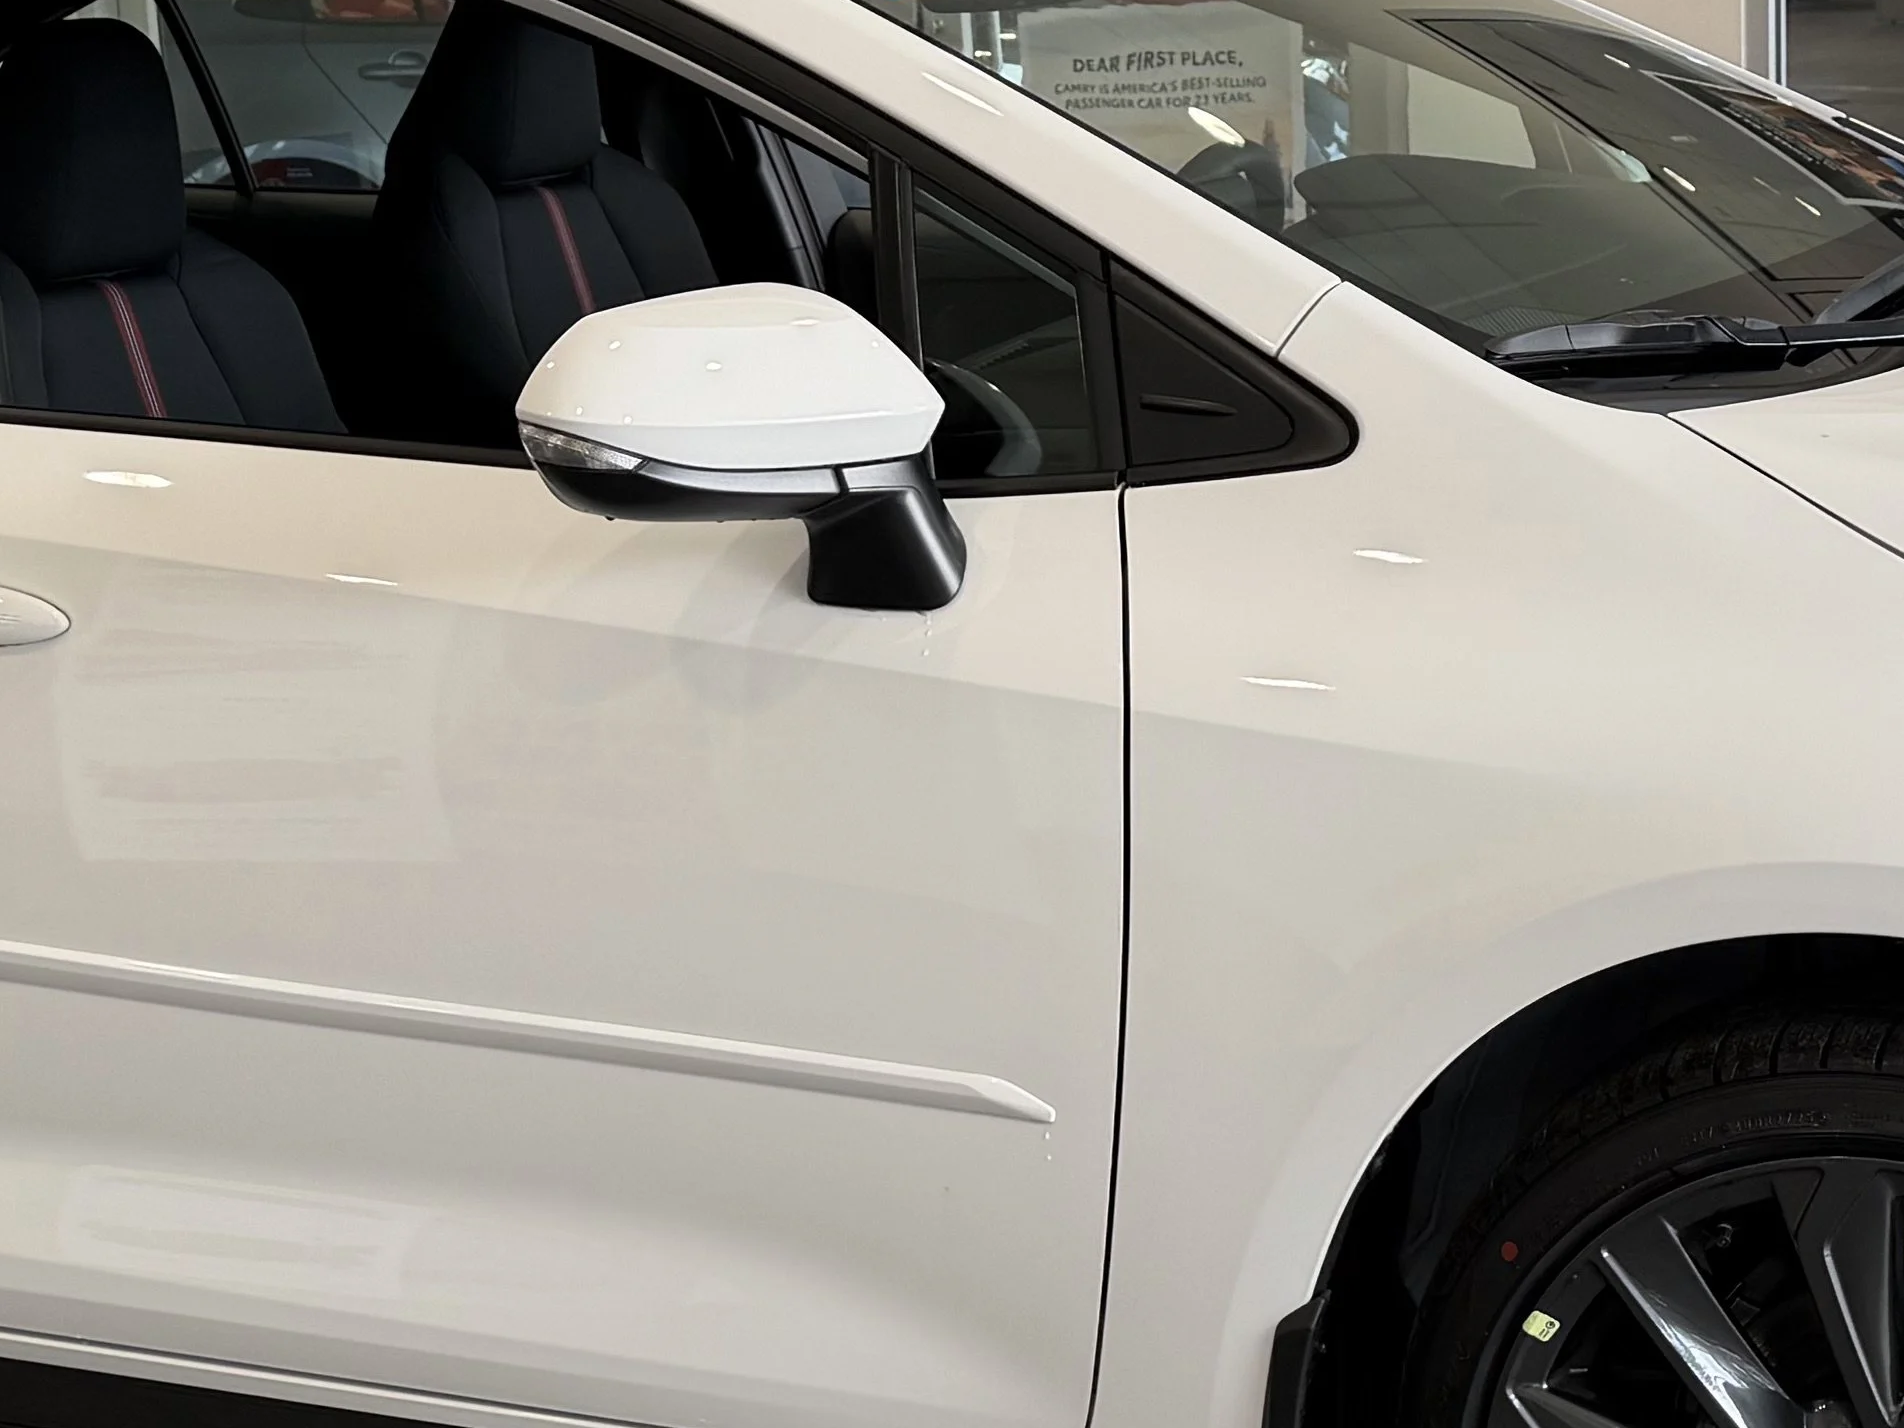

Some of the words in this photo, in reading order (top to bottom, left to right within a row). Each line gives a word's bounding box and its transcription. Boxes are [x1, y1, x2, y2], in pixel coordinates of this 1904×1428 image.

[1072, 54, 1121, 74] DEAR
[1126, 50, 1176, 72] FIRST
[1181, 49, 1244, 69] PLACE,
[1054, 82, 1096, 96] CAMRY
[1098, 82, 1110, 95] IS
[1112, 79, 1178, 95] AMERICA'S
[1181, 75, 1267, 92] BEST-SELLING
[1065, 96, 1135, 111] PASSENGER
[1137, 96, 1163, 109] CAR
[1166, 95, 1192, 109] FOR
[1213, 91, 1255, 105] YEARS.
